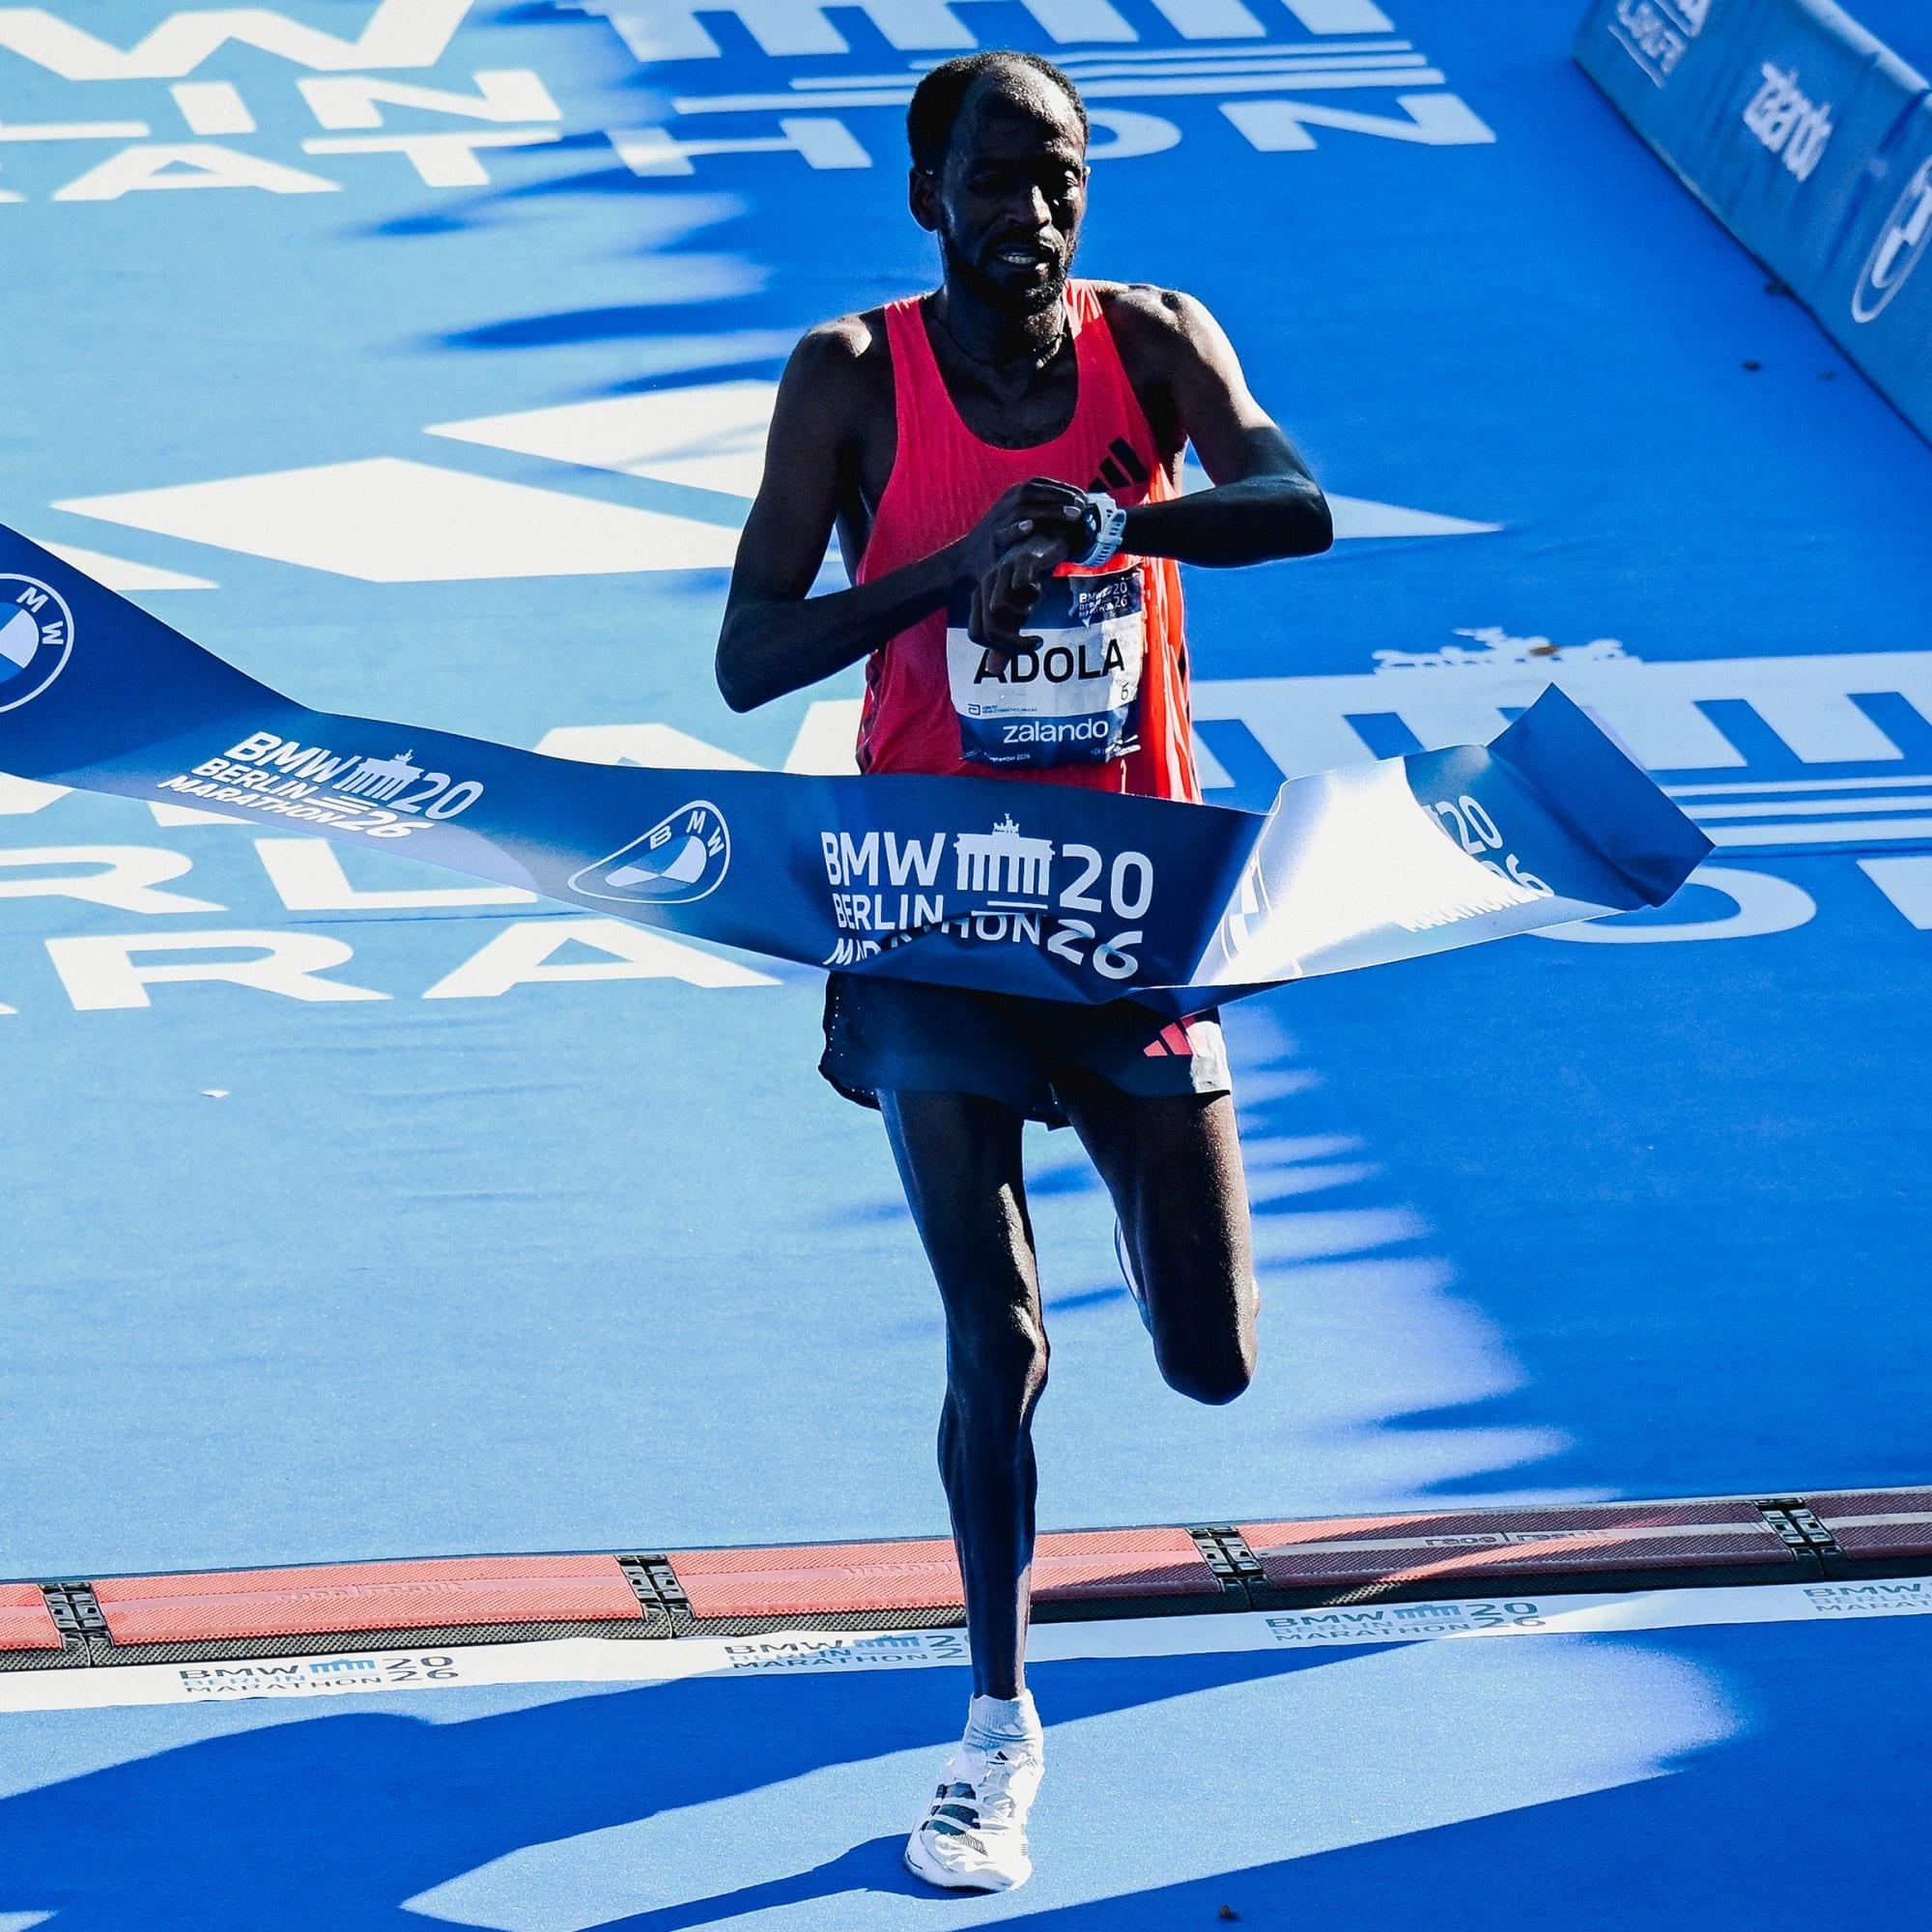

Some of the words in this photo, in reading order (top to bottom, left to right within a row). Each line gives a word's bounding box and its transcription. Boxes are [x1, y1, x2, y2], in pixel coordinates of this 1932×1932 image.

[973, 639, 1125, 684] ADOLA
[1003, 718, 1109, 744] zalando
[190, 757, 320, 801] BERLIN
[223, 731, 361, 783] BMW
[386, 772, 484, 820] 20
[156, 775, 349, 825] MARATHON
[327, 810, 435, 838] 26
[1435, 795, 1503, 855] 20
[820, 831, 946, 887] BMW
[1060, 843, 1153, 920] 20
[832, 893, 944, 931] BERLIN
[1046, 918, 1143, 980] 26
[1803, 1583, 1921, 1597] BMW
[1265, 1610, 1384, 1628] BMW
[1466, 1602, 1539, 1616] 20
[1271, 1620, 1394, 1634] BERLIN
[1275, 1623, 1470, 1641] MARATHON
[1471, 1615, 1547, 1629] 26
[724, 1639, 843, 1655] BMW
[925, 1634, 968, 1648] 2
[179, 1664, 299, 1680] BMW
[383, 1656, 454, 1670] 20
[732, 1654, 929, 1669] MARATHON
[933, 1647, 968, 1660] 2
[186, 1677, 383, 1693] MARATHON
[386, 1668, 460, 1683] 26
